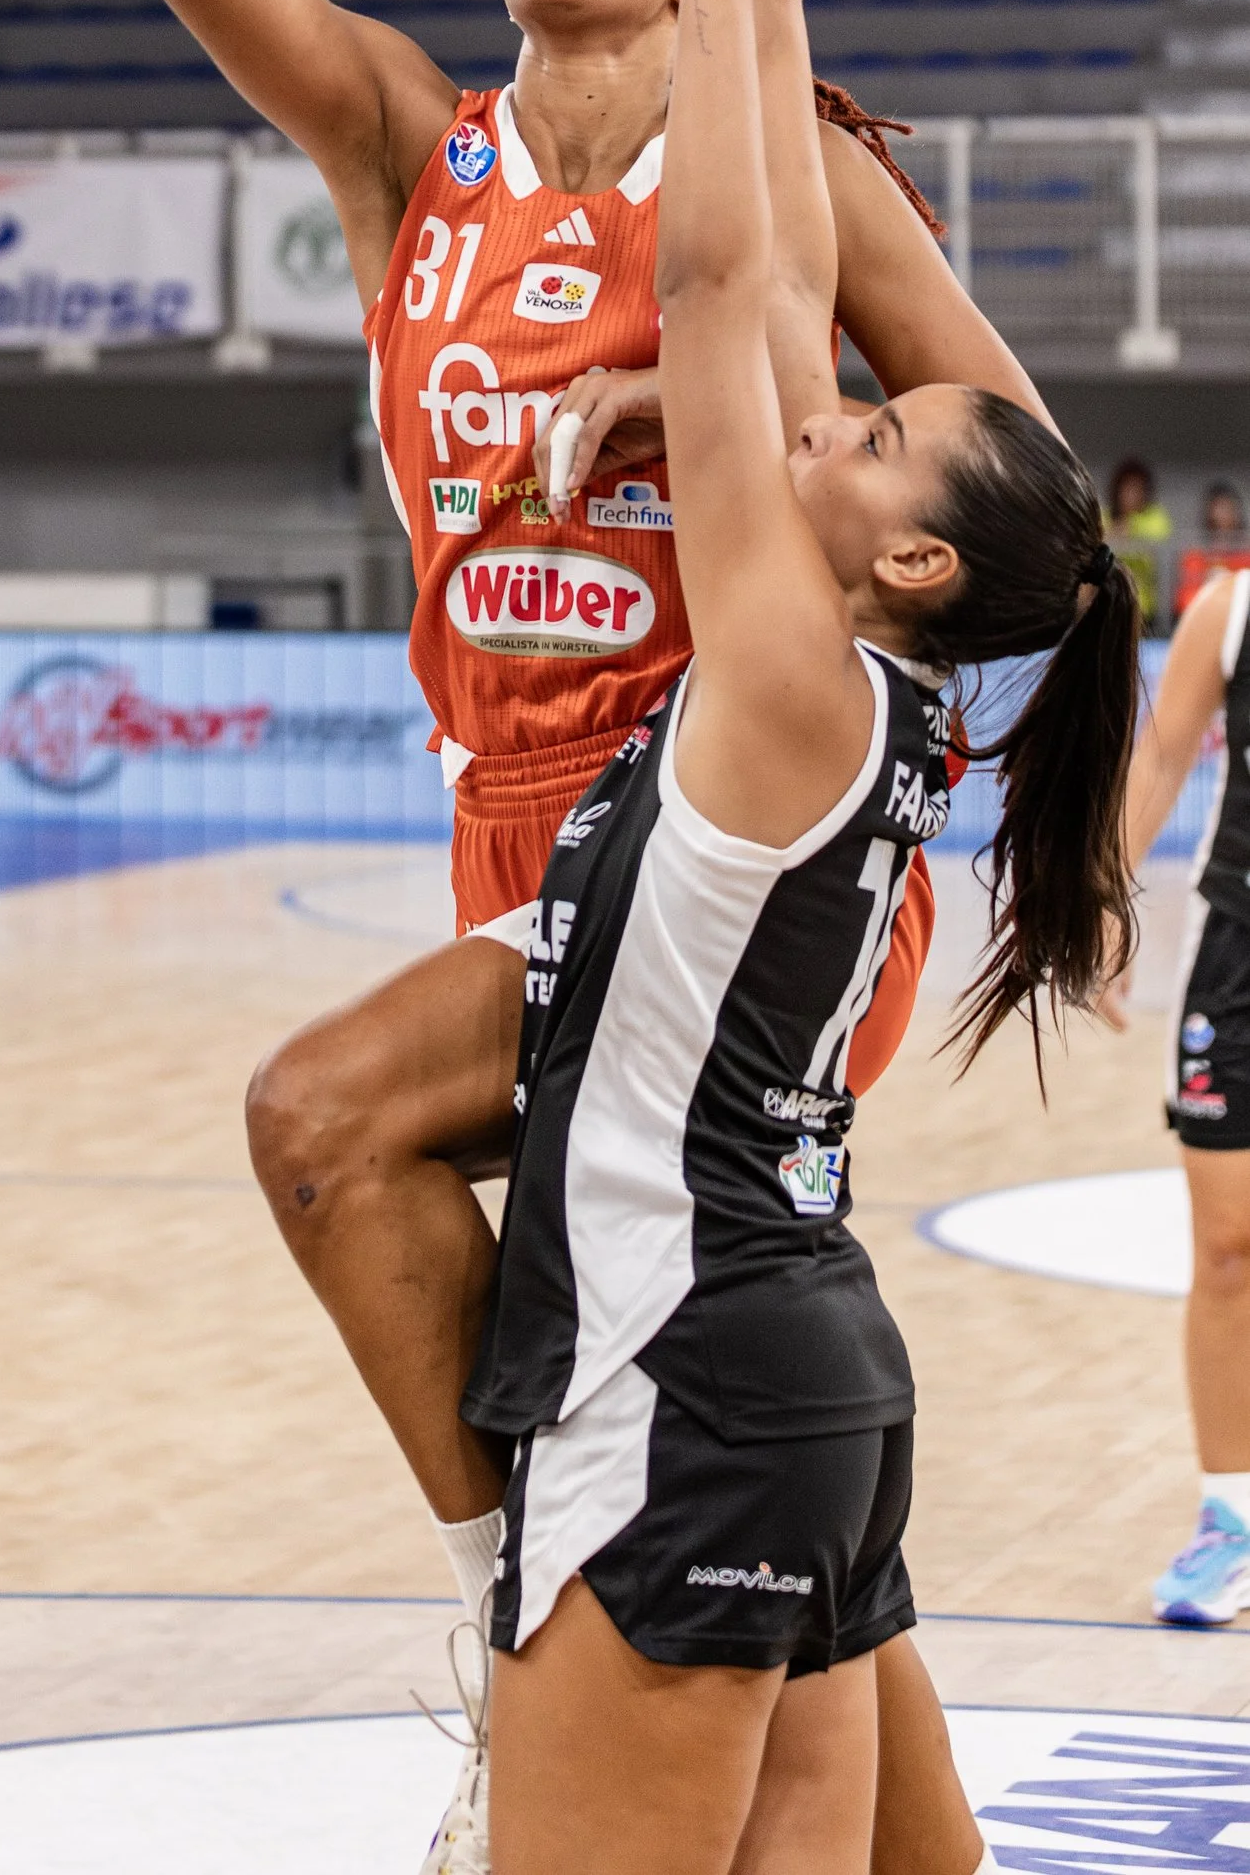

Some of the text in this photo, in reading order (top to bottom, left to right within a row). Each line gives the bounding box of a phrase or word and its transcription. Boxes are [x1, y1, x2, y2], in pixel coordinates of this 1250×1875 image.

[456, 152, 487, 180] LBF
[404, 215, 485, 322] 31
[525, 295, 583, 310] VENOSTA
[418, 342, 568, 463] fam
[434, 484, 478, 515] HDI
[520, 515, 550, 525] ZERO
[461, 565, 641, 632] Wüber
[479, 637, 539, 650] SPECIALISTA
[541, 640, 550, 650] IN
